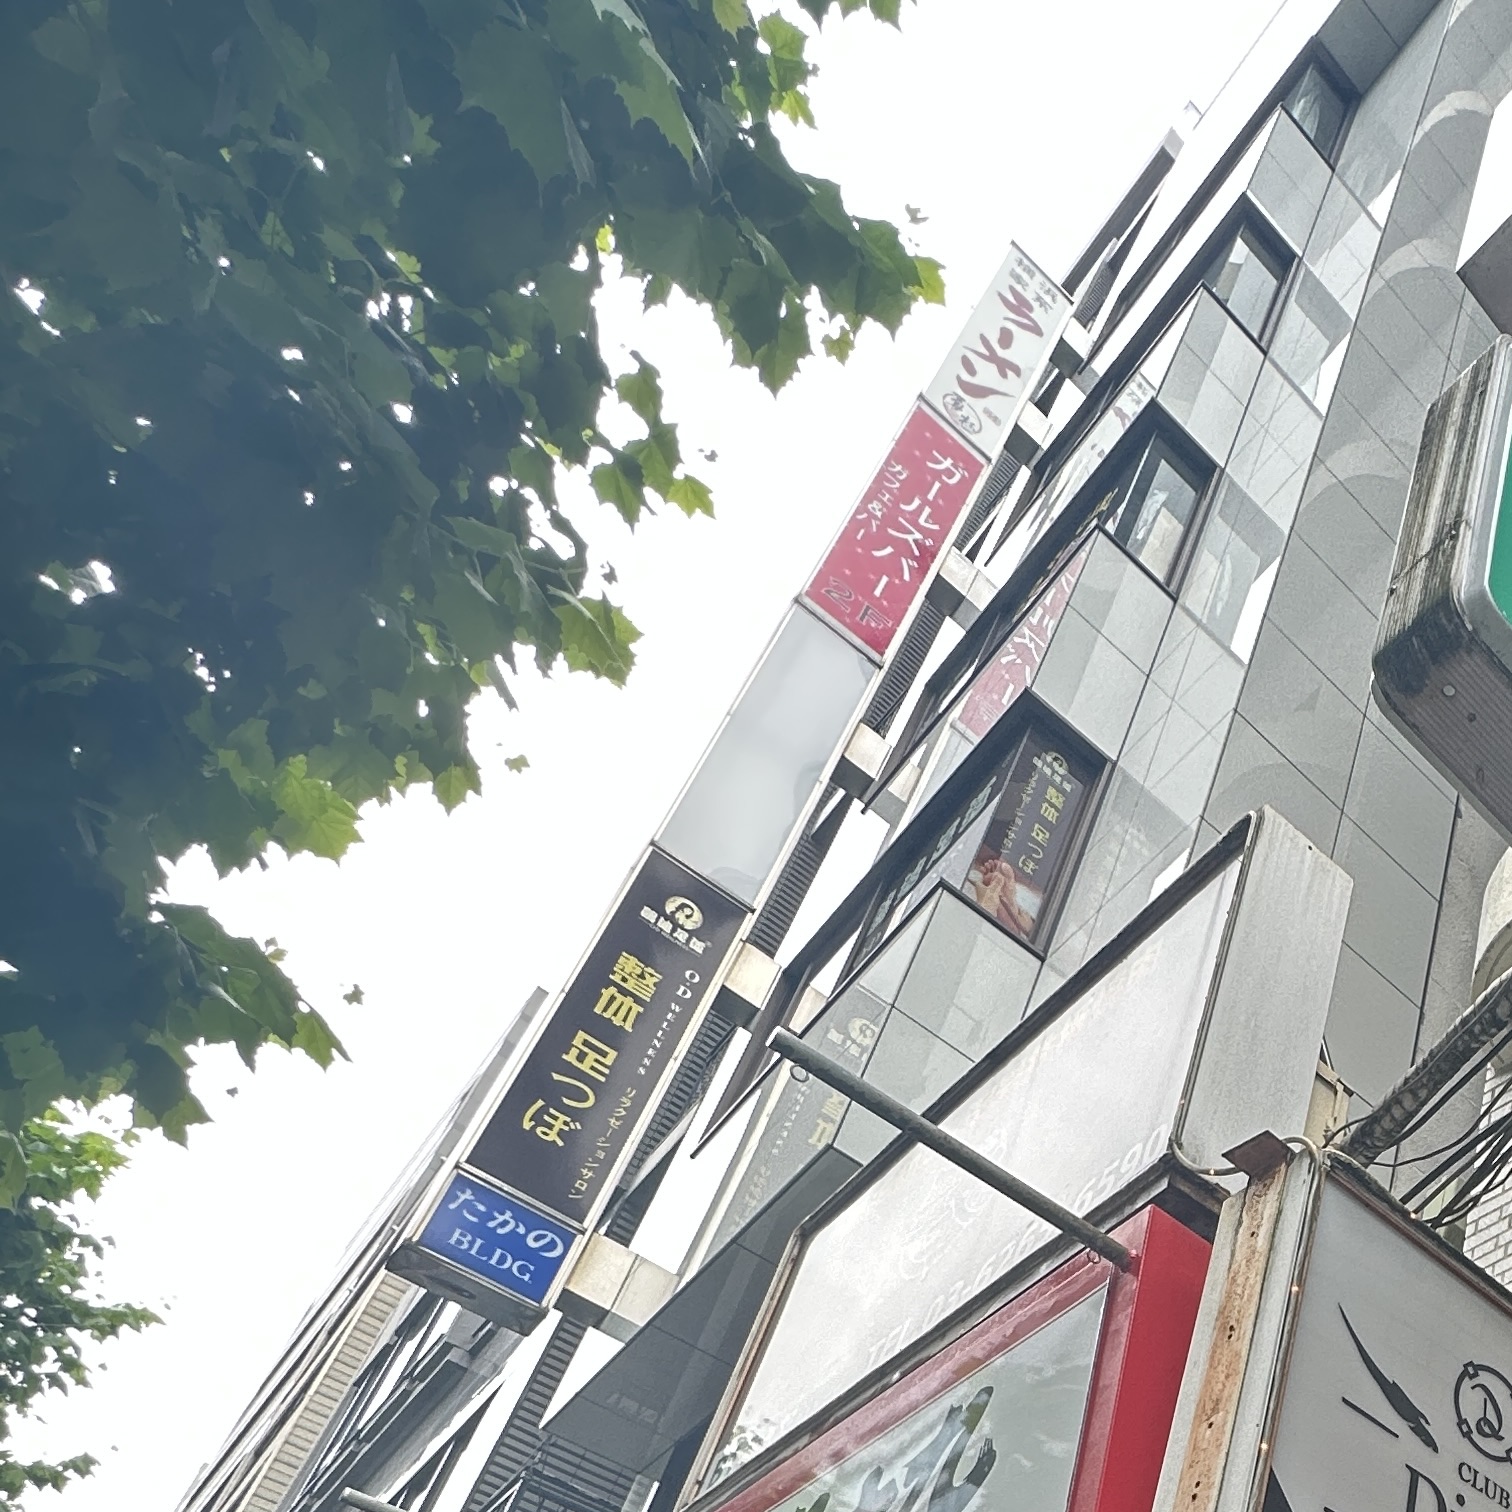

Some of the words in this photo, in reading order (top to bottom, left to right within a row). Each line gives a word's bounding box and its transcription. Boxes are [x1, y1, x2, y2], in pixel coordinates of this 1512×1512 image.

[871, 450, 970, 598] ガールズバー
[821, 576, 893, 629] 2F
[594, 950, 663, 1033] 整体
[522, 1030, 619, 1148] 足つぼ
[567, 1086, 636, 1200] リラクゼーションサロン
[448, 1186, 565, 1260] たかの
[1458, 1460, 1511, 1509] CLUB
